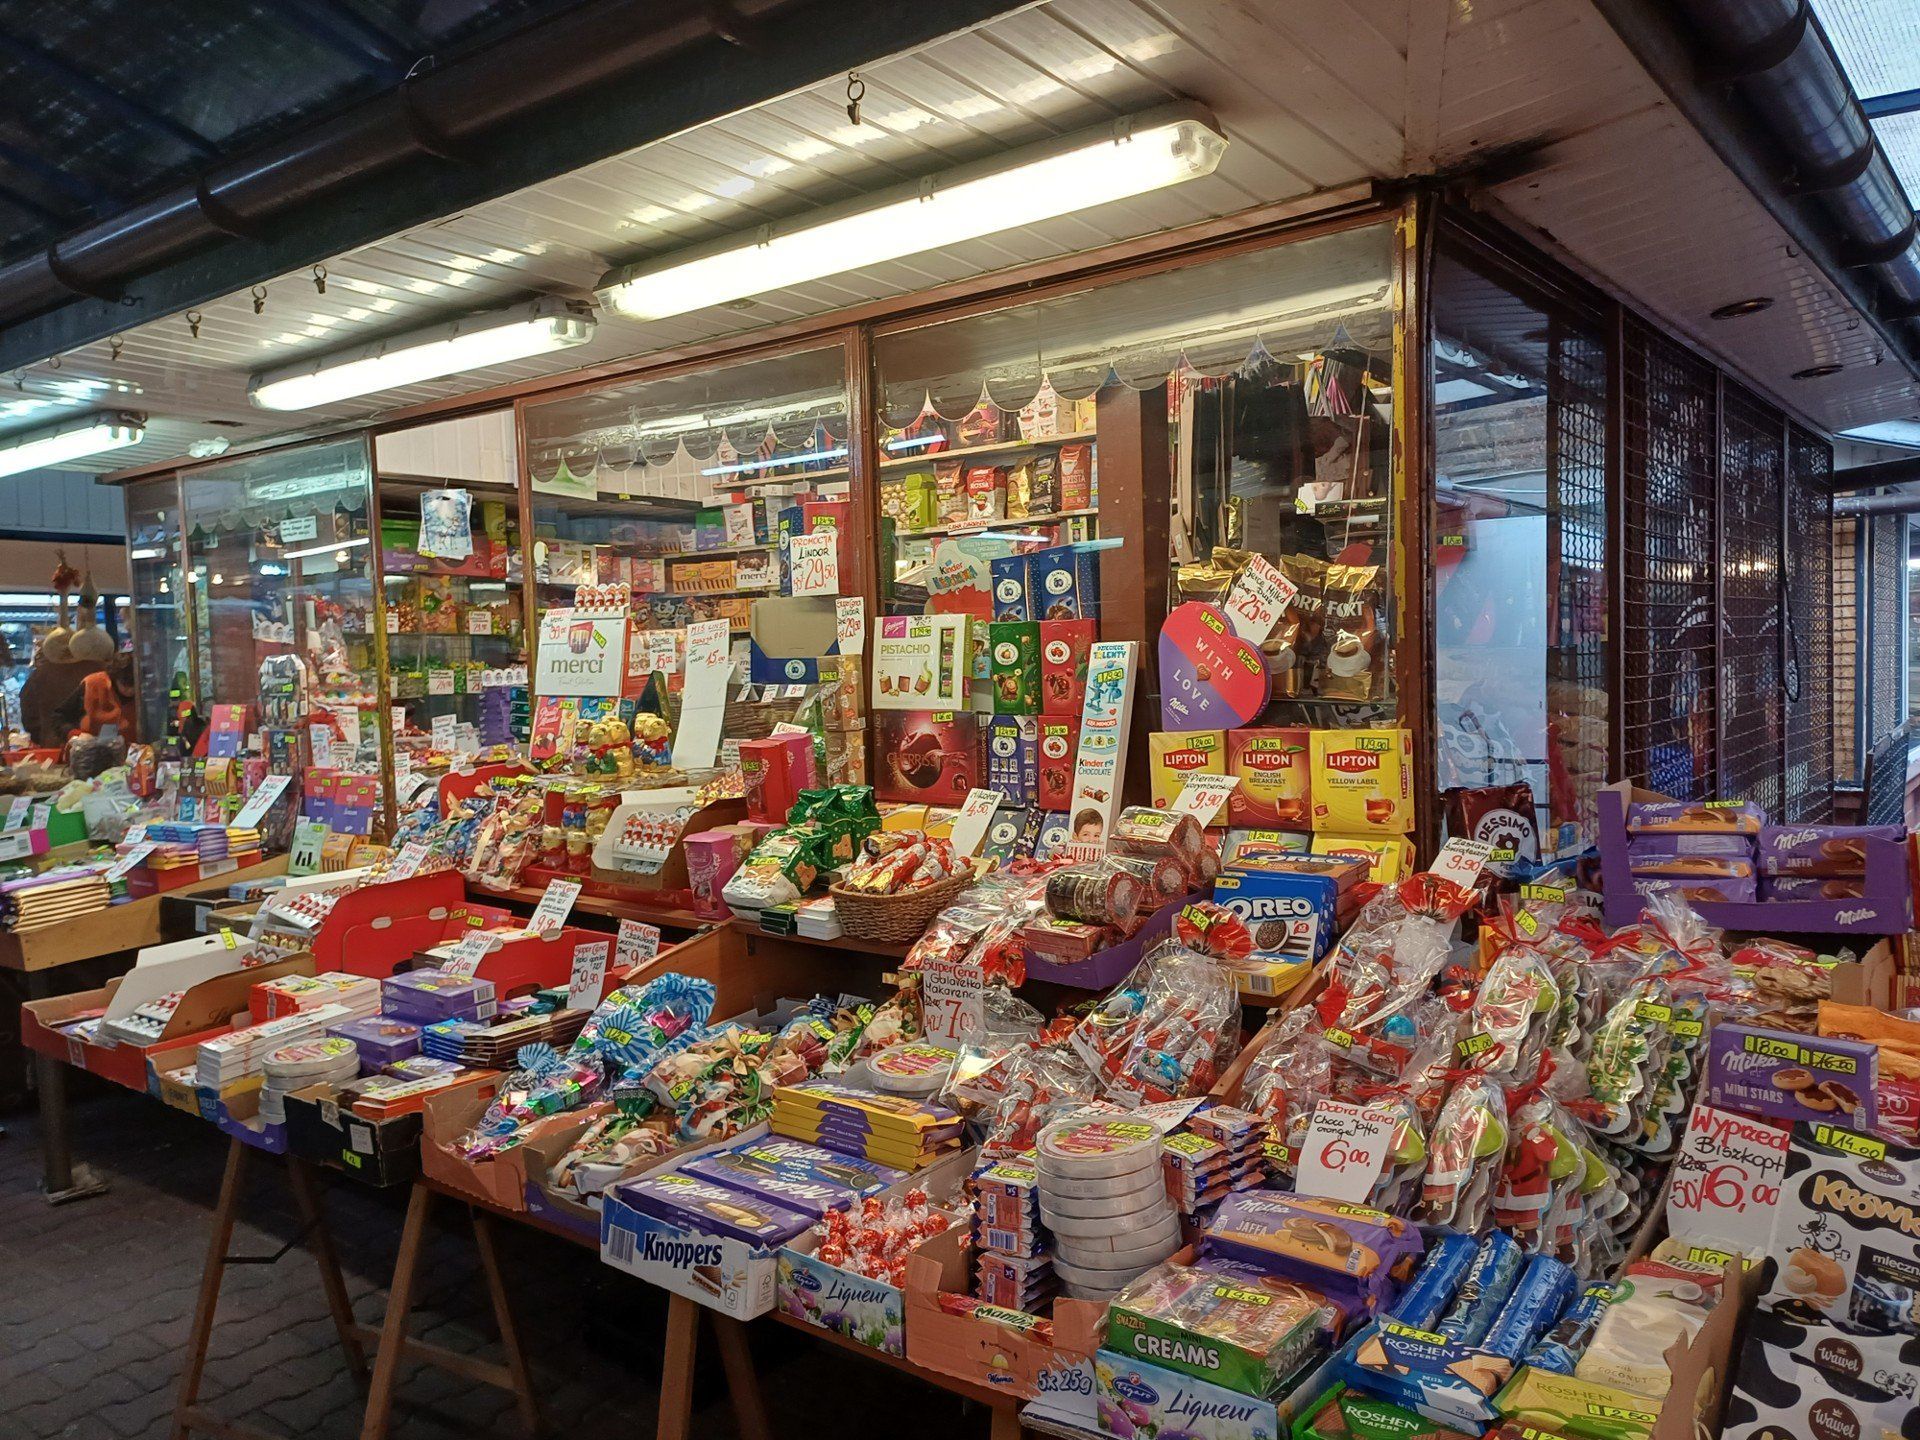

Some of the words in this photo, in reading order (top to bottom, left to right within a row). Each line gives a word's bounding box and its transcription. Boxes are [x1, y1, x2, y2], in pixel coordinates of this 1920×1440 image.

[1327, 600, 1365, 618] FORT
[880, 644, 930, 654] PISTACHIO
[1195, 636, 1234, 682] WITH
[550, 653, 603, 673] merci
[1173, 669, 1210, 711] LOVE
[1169, 697, 1191, 716] Milka
[1165, 753, 1206, 765] LIPTON
[1245, 753, 1290, 765] LIPTON
[1329, 755, 1377, 766] LIPTON
[1078, 766, 1112, 776] CHOCOLATE
[1478, 815, 1530, 842] DESSIMO
[1774, 830, 1820, 850] Milka
[1786, 857, 1812, 868] JAFFA
[1230, 898, 1311, 919] OREO
[1835, 910, 1878, 925] Milka
[1721, 1050, 1780, 1072] Milka
[1725, 1082, 1748, 1098] MINI
[1750, 1085, 1784, 1104] STARS
[1314, 1115, 1344, 1126] Choco
[1316, 1101, 1358, 1116] Dobra
[1362, 1110, 1394, 1125] Cena
[1694, 1136, 1786, 1178] Biszkopt
[1236, 1220, 1267, 1236] JAFFA
[643, 1232, 723, 1270] Knoppers
[826, 1279, 890, 1311] Liqueur
[1134, 1333, 1220, 1370] CREAMS
[1385, 1338, 1455, 1359] ROSHEN
[1399, 1351, 1438, 1361] WAFERS
[1820, 1348, 1859, 1373] Wawel
[1421, 1374, 1443, 1384] Milk
[1403, 1388, 1424, 1402] Milk
[1536, 1381, 1613, 1402] ROSHEN
[1165, 1389, 1259, 1429] Liqueur
[1346, 1406, 1420, 1432] ROSHEN
[1814, 1409, 1855, 1438] Wawel
